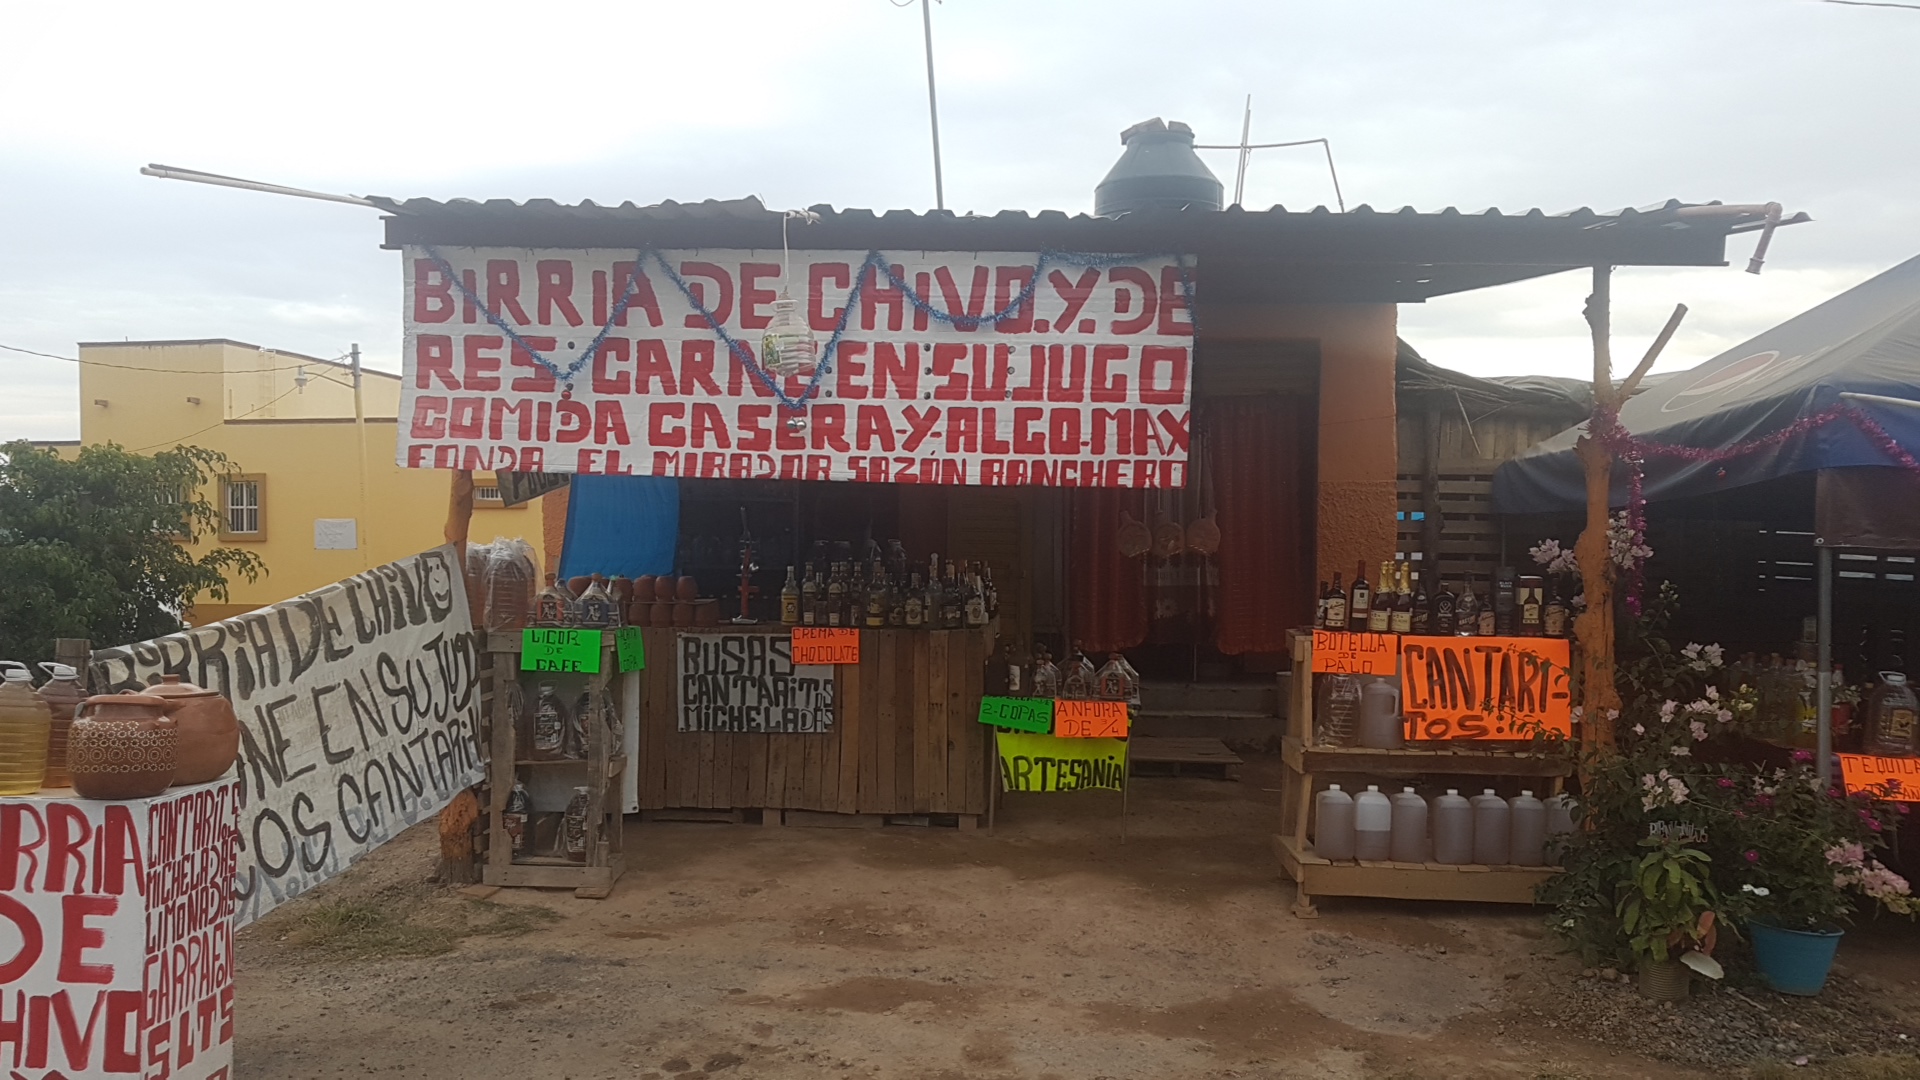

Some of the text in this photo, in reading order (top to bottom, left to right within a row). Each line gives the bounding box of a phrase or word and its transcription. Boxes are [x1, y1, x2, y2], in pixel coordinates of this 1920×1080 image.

[413, 258, 664, 327] BIRRIA
[680, 261, 782, 329] DE
[415, 334, 558, 392] RES
[836, 340, 920, 400] EN
[932, 343, 1008, 401] SU
[1012, 344, 1188, 404] JUGO
[410, 396, 630, 446] COMIDA
[407, 444, 544, 472] FONDA
[577, 449, 632, 475] EL
[651, 451, 831, 481] MIRADOR
[980, 459, 1187, 488] RANCHERO
[280, 586, 354, 684] DE
[531, 630, 581, 646] LICOR
[544, 645, 563, 655] DE
[793, 628, 835, 639] CREMA
[793, 645, 858, 663] CHOCOLATE
[1314, 632, 1388, 652] BOTELLA
[536, 659, 582, 672] CAFE
[684, 636, 796, 676] RUSAS
[1320, 658, 1372, 674] PALO
[237, 694, 317, 810] NE
[311, 669, 389, 764] EN
[377, 652, 432, 736] SU
[1064, 719, 1091, 737] DE
[1842, 757, 1920, 775] TEQUILA
[147, 781, 241, 869] CANTARITOS
[146, 834, 238, 912] MICHELADAS
[145, 872, 236, 954] LIMONADAS
[143, 920, 235, 1030] GARRAFON
